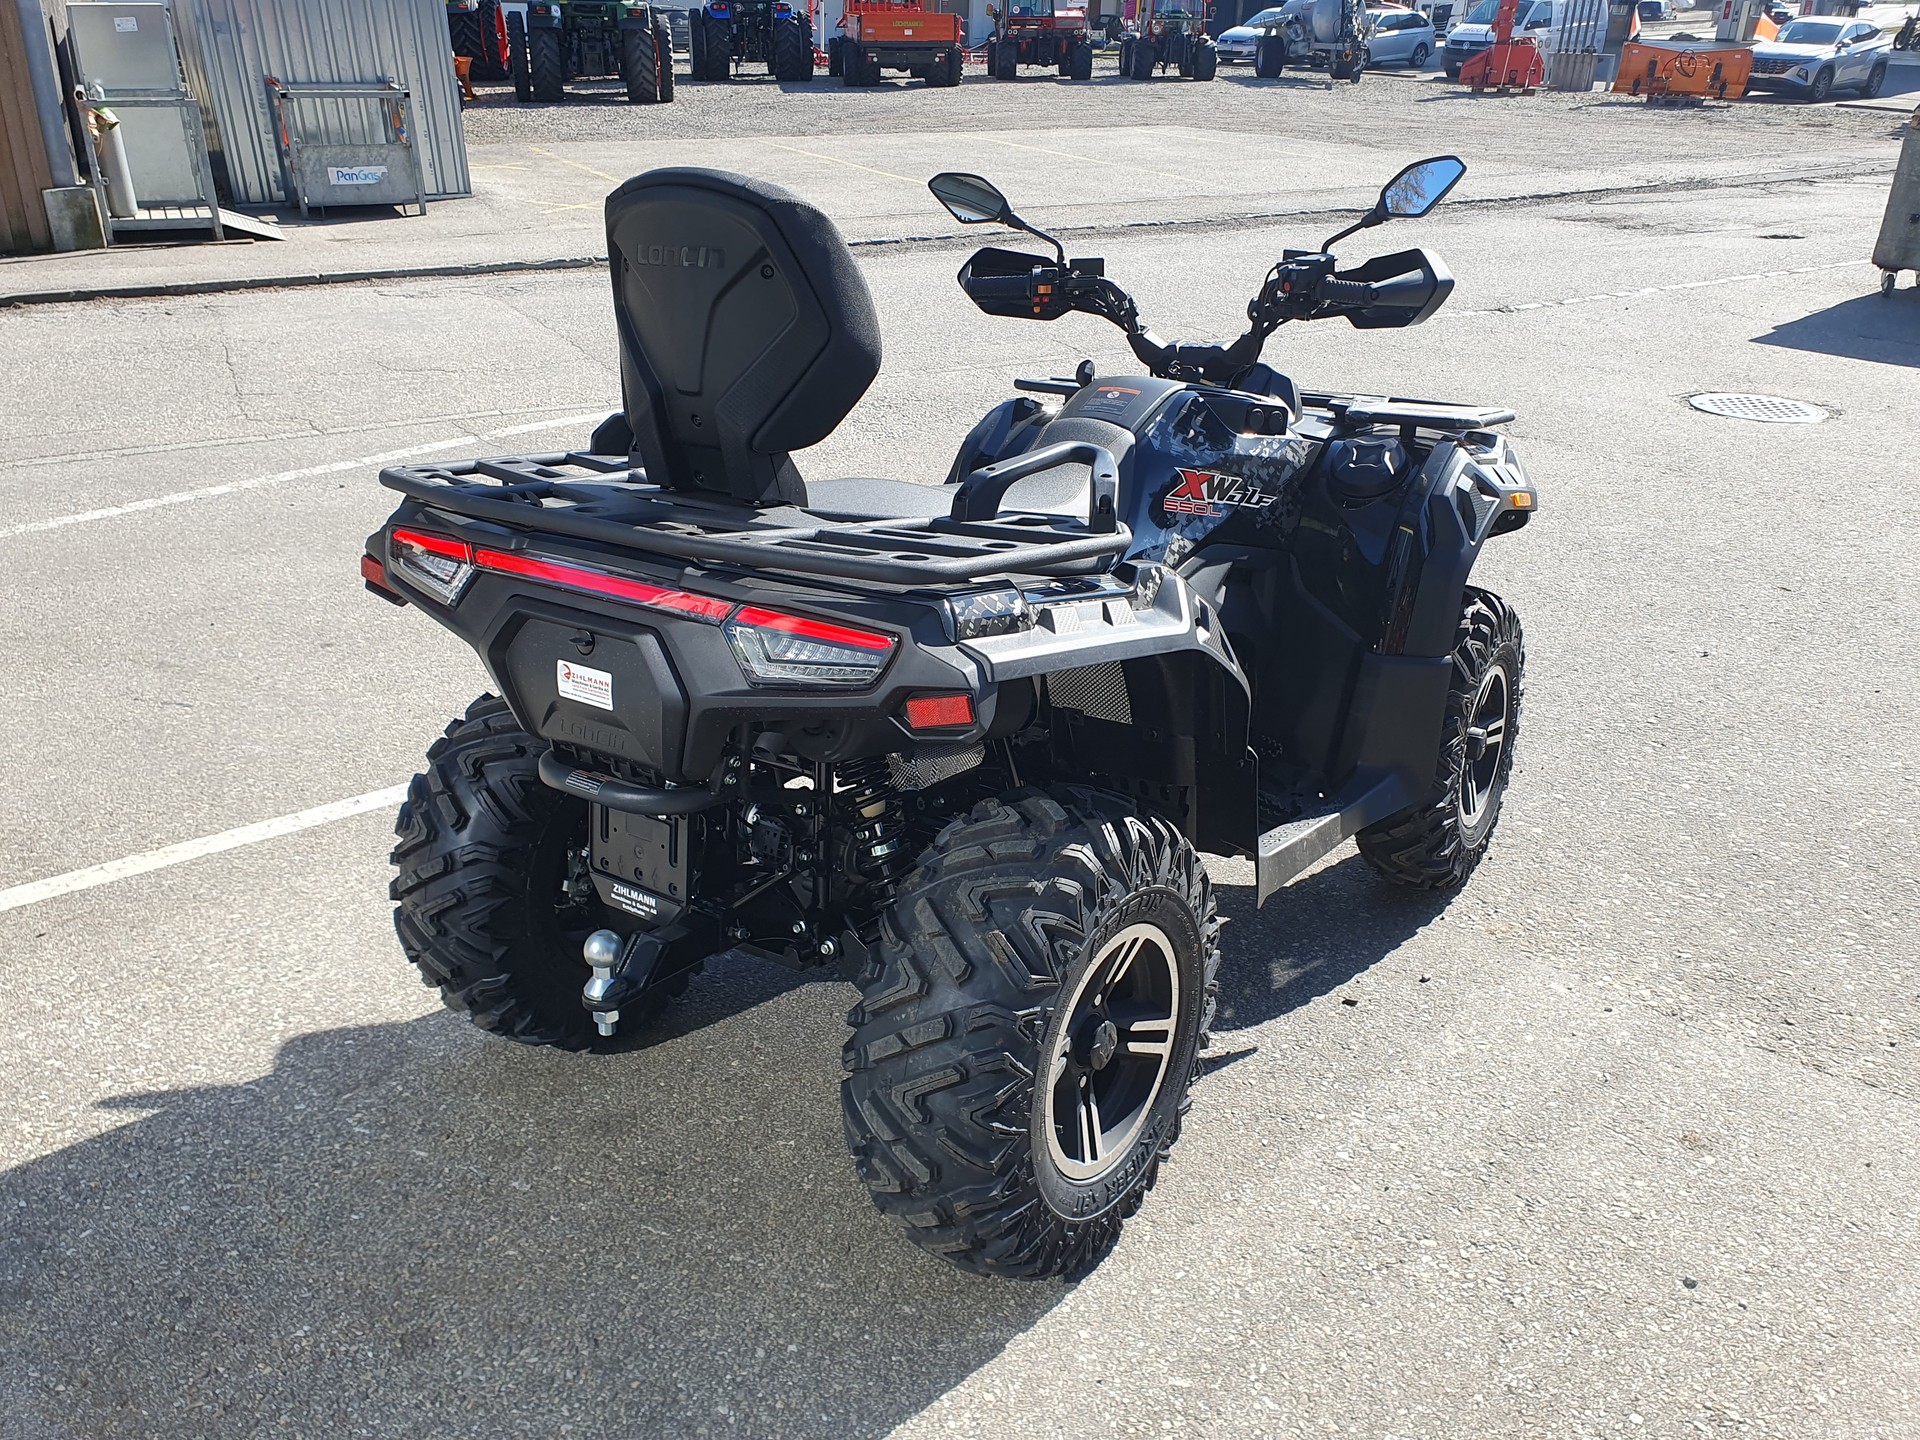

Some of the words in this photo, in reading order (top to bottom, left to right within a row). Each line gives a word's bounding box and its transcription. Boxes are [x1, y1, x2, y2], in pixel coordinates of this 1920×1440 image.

[336, 169, 381, 181] PanGas
[571, 672, 610, 688] ZIHLMANN
[613, 883, 656, 907] ZIHLMANN
